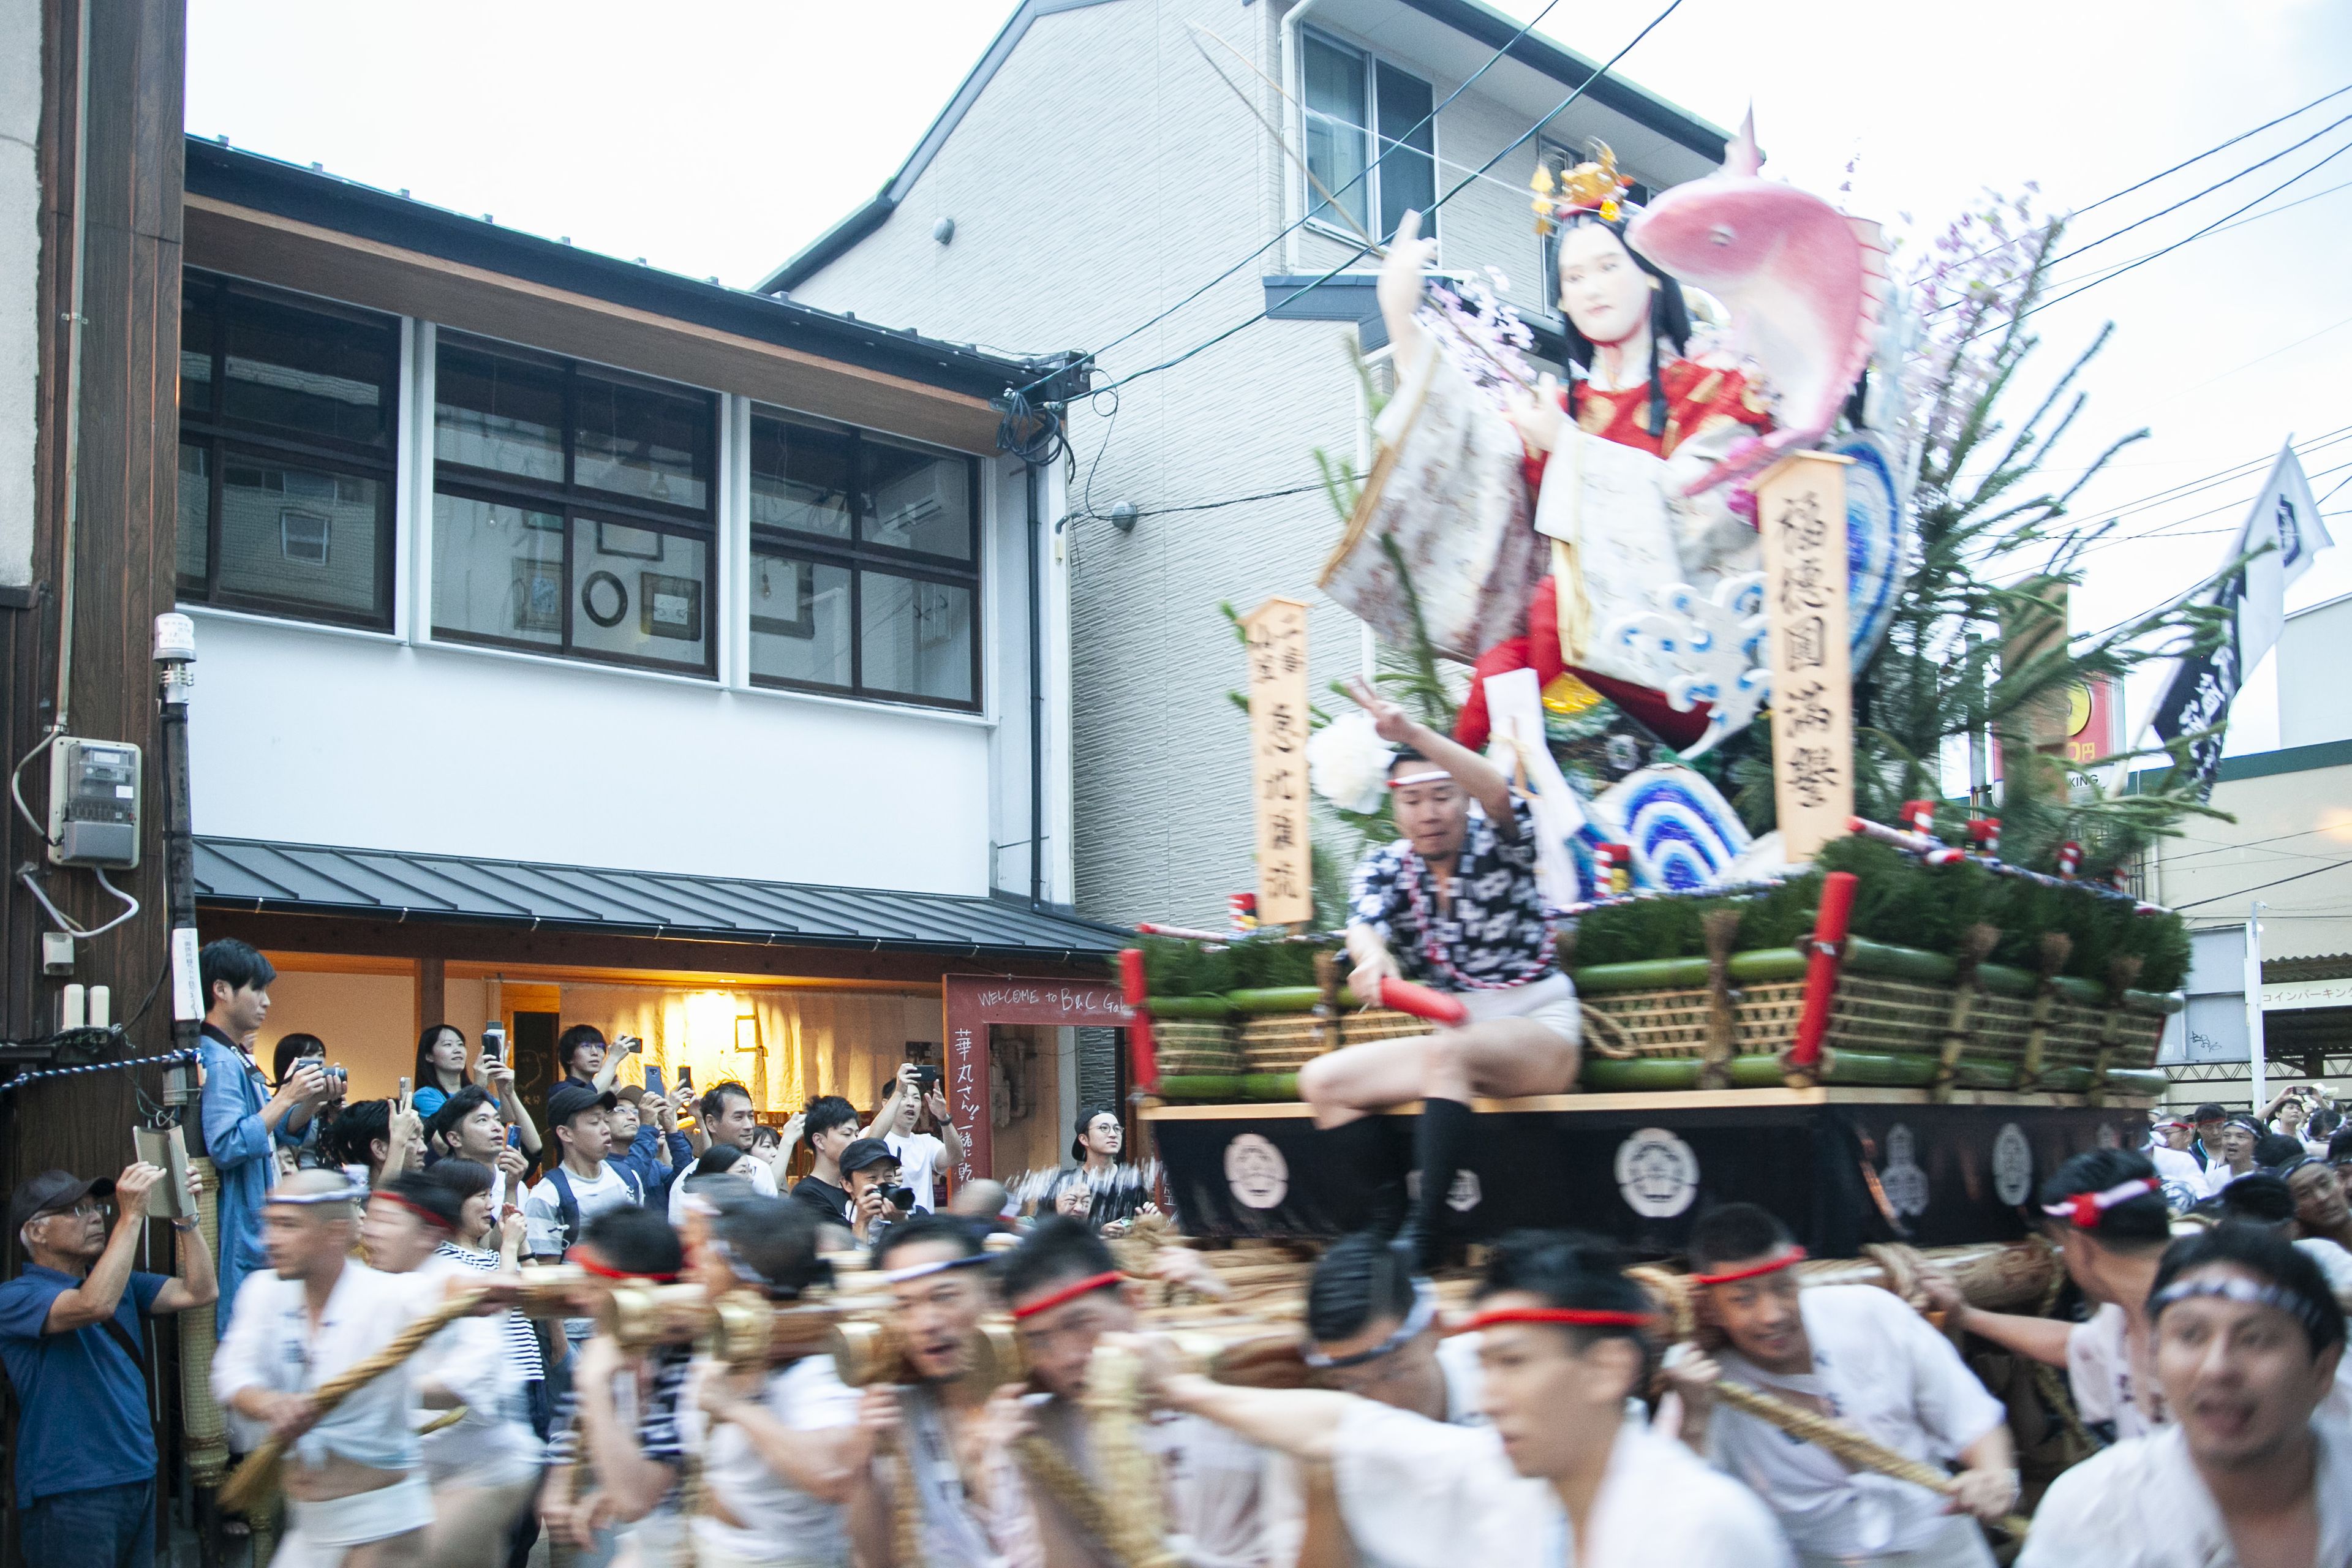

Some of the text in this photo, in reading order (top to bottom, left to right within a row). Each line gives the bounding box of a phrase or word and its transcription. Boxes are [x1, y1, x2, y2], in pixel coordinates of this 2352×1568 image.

[2067, 741, 2095, 763] 0円
[2069, 774, 2098, 788] KING
[978, 989, 1039, 1006] WELCOME
[1046, 992, 1057, 1002] to
[1103, 993, 1128, 1013] Gal
[955, 1028, 980, 1194] 華丸さん!一緒に乾
